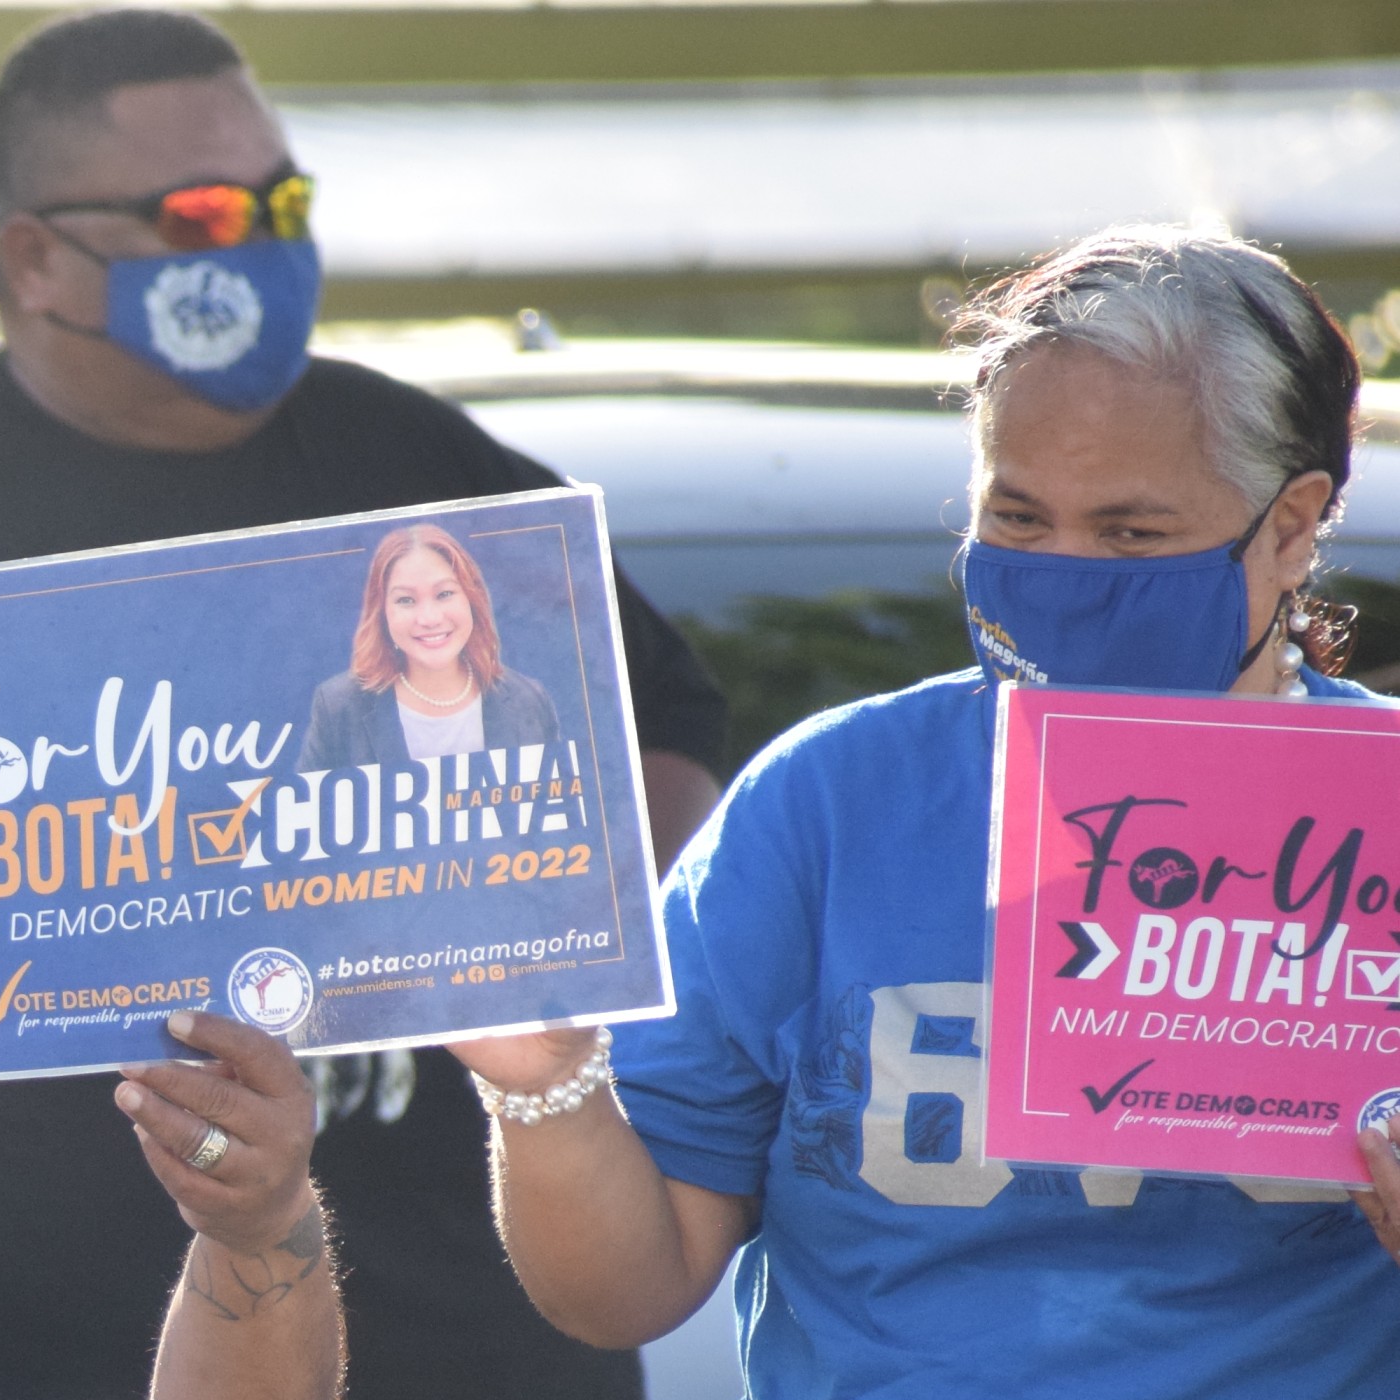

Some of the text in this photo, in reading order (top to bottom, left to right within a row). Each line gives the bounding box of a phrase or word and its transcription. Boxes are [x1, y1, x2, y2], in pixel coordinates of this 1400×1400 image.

[95, 676, 292, 836] You
[258, 740, 586, 866] CORINA
[446, 778, 584, 810] MAGOFNA
[10, 886, 253, 942] DEMOCRATIC
[263, 863, 426, 912] WOMEN
[436, 857, 474, 891] IN
[485, 844, 591, 886] 2022
[1063, 795, 1400, 961] For Yo
[318, 928, 610, 980] #botacorinamagofna
[322, 957, 578, 998] www.nmidems.org @nmidems
[1123, 914, 1350, 1009] BOTA!
[62, 976, 210, 1012] DEMOCRATS
[17, 1012, 42, 1036] for
[44, 1007, 121, 1033] responsible
[1050, 1006, 1400, 1054] NMI DEMOCRATIC
[1113, 1109, 1345, 1138] for responsible government
[1175, 1091, 1341, 1121] DEMOCRATS
